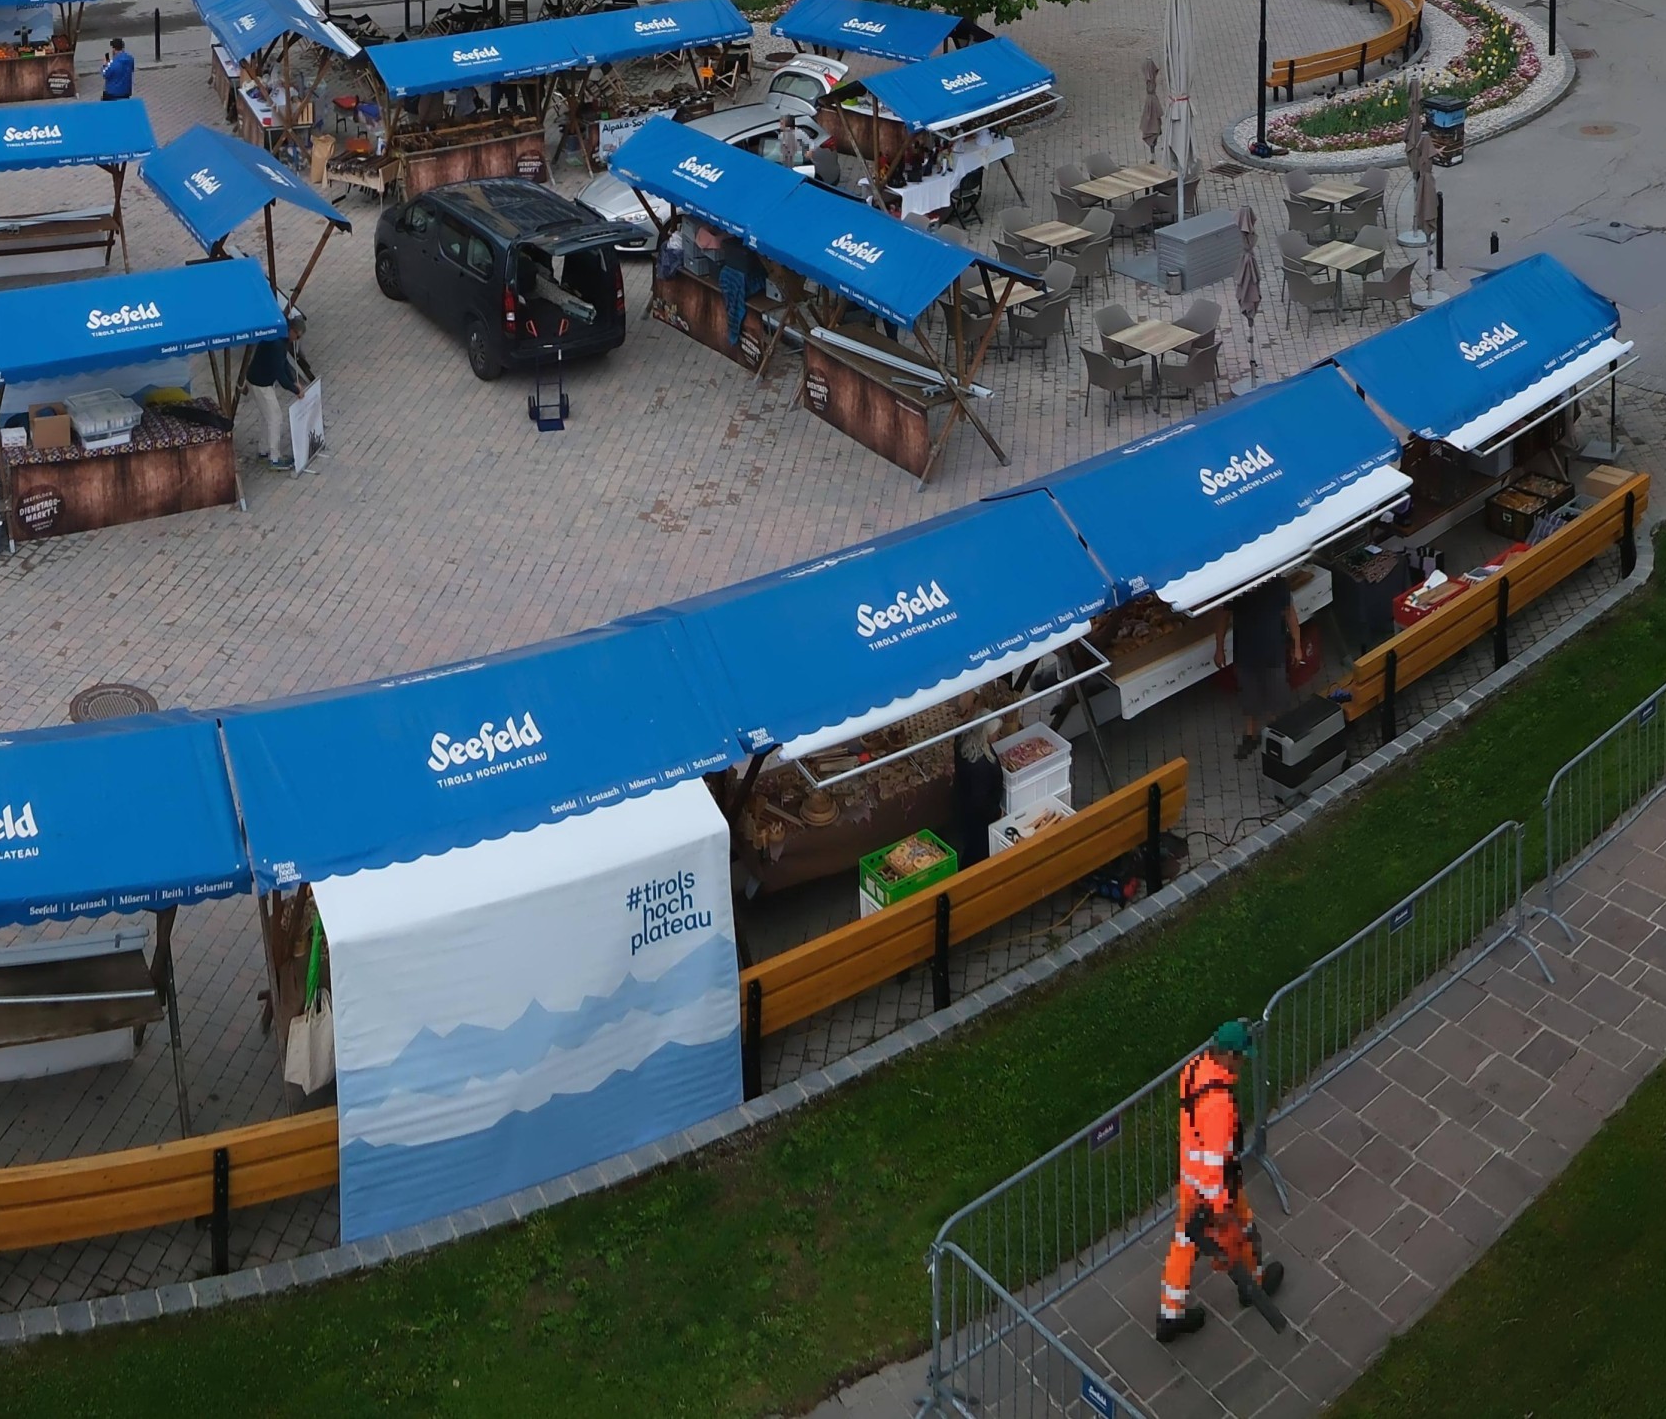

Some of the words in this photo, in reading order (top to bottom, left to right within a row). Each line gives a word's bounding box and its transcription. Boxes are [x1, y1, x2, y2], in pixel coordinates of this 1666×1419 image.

[452, 46, 500, 63] Seefeld
[2, 124, 62, 141] Seefeld
[831, 233, 885, 264] Seefeld
[86, 301, 162, 330] Seefeld
[1459, 322, 1519, 362] Seefeld
[1200, 444, 1275, 496] Seefeld
[1214, 490, 1238, 507] TIROLS
[856, 579, 951, 639] Seefeld
[868, 633, 899, 652] TIROLS
[900, 611, 959, 641] HOCHPLATEAU
[427, 711, 543, 774] Seefeld
[437, 771, 474, 788] TIROLS
[474, 751, 549, 782] HOCHPLATEAU
[549, 797, 577, 817] Seefeld
[586, 785, 621, 806] Leutasch
[627, 774, 658, 793] Mösern
[664, 765, 686, 782] Reith
[692, 751, 728, 772] Scharnitz
[29, 903, 59, 916] Seefeld
[70, 897, 108, 913] Leutasch
[118, 892, 151, 908] Mösern
[161, 885, 184, 899] Reith
[193, 879, 235, 896] Scharnitz
[626, 870, 696, 912] #tirols
[643, 886, 694, 923] hoch
[630, 908, 712, 956] plateau
